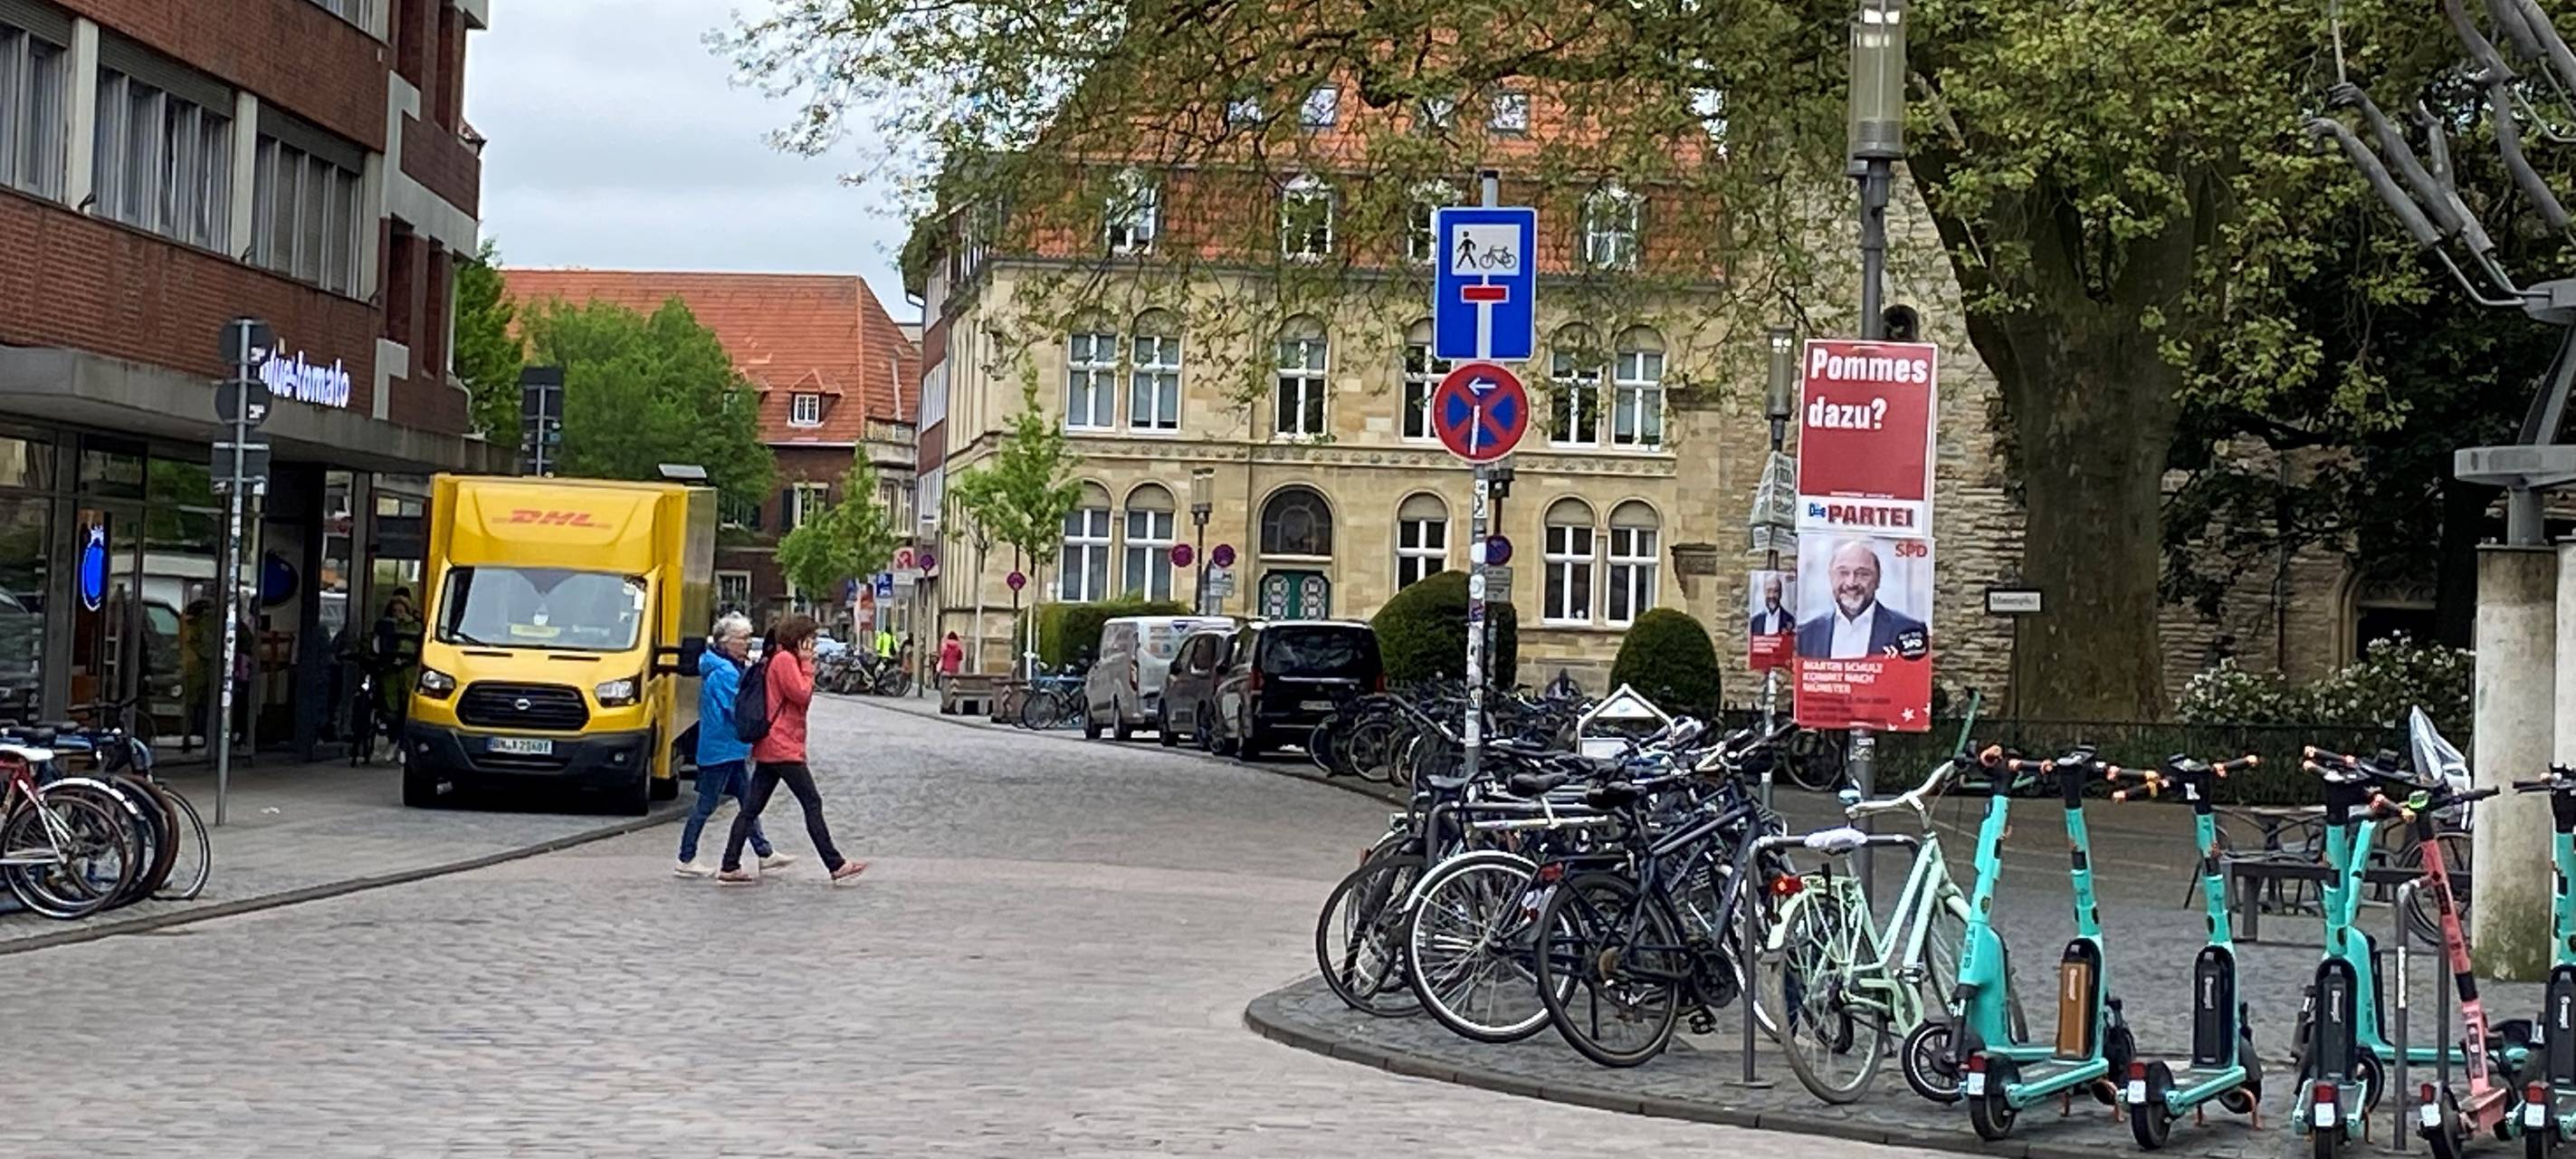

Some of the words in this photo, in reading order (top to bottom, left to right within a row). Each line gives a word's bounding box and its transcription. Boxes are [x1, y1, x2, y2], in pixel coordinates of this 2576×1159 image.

[1810, 347, 1928, 384] Pommes
[1808, 396, 1888, 430] dazu?
[508, 509, 595, 528] DHL
[1827, 503, 1914, 528] PARTEI
[1894, 540, 1929, 558] SPD
